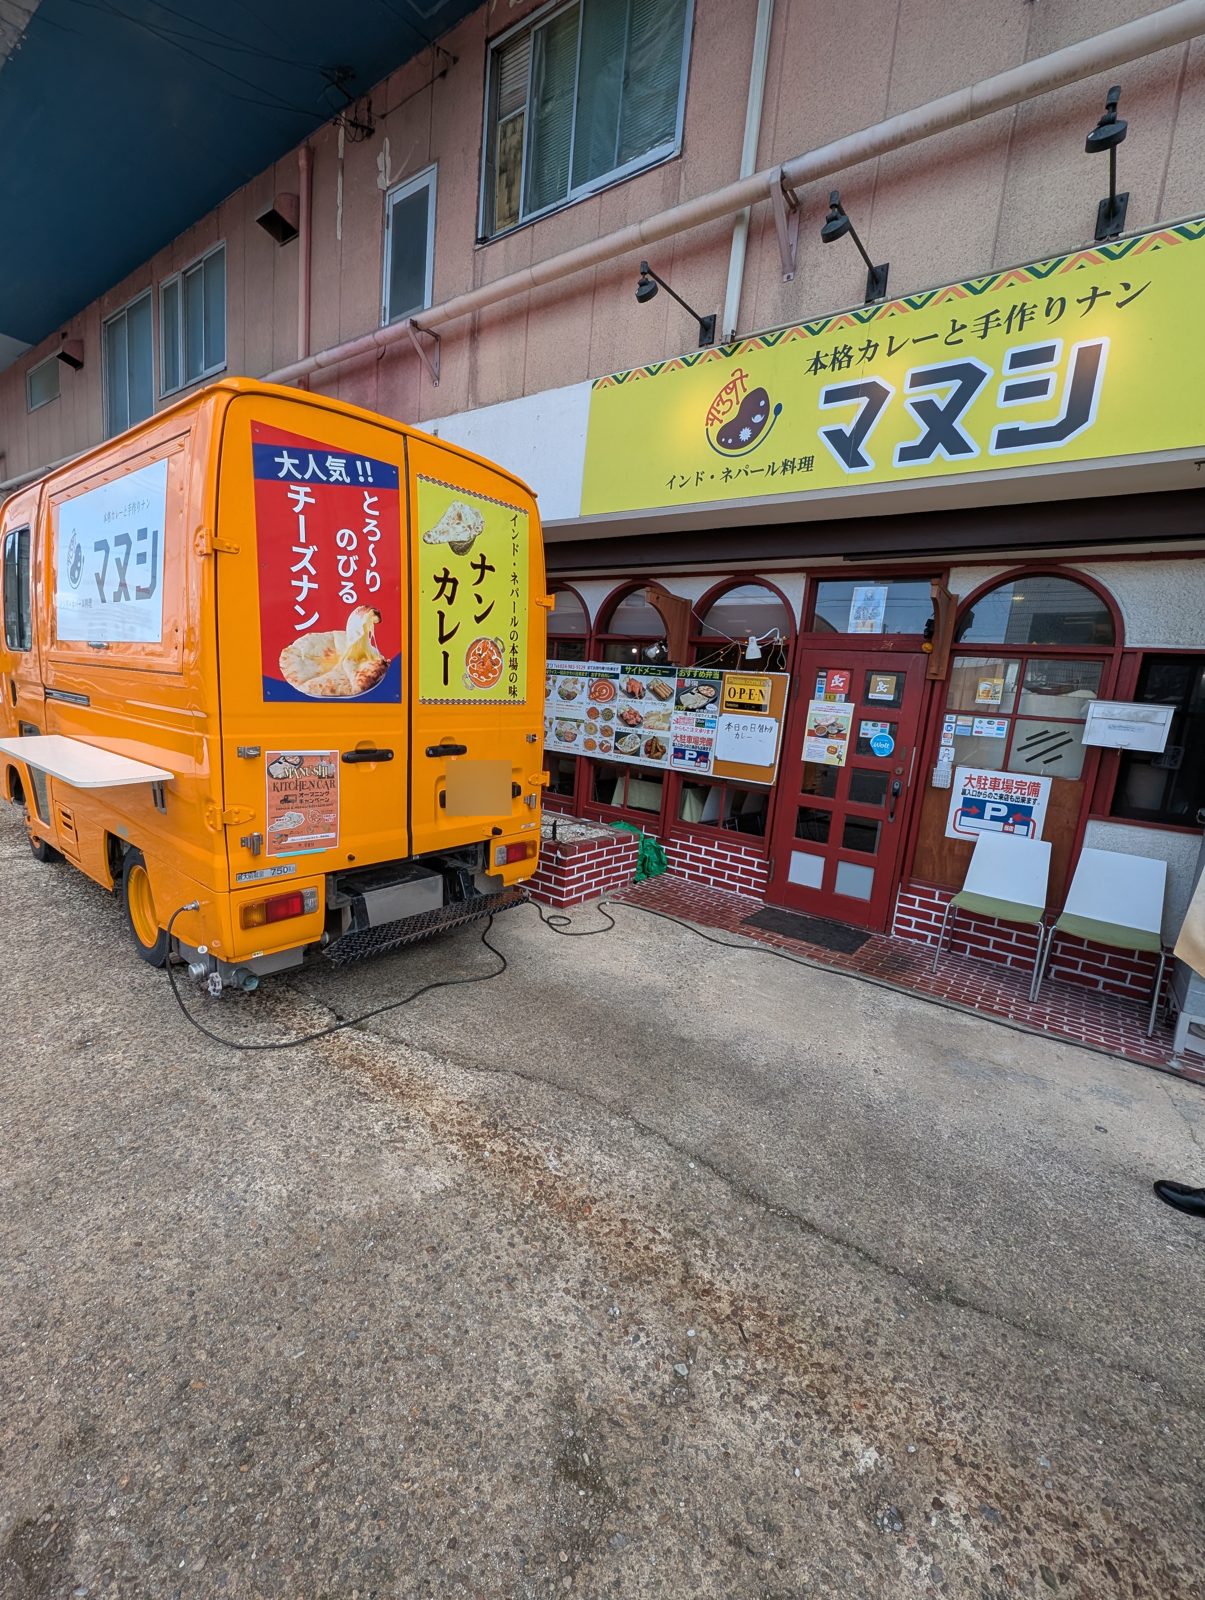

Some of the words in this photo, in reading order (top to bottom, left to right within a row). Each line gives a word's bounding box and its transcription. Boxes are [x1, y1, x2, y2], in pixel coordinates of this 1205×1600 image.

[803, 280, 1152, 377] 本格カレーと手作りナン
[819, 338, 1108, 471] マヌシ
[664, 454, 815, 490] インド・ネパール料理
[93, 527, 159, 604] マヌシ
[287, 484, 320, 631] チーズナン
[335, 528, 359, 604] のびる
[470, 552, 496, 624] ナン
[432, 567, 461, 686] カレー
[507, 514, 520, 698] インド・ネパールの本場の味
[625, 666, 670, 676] サイドメニュー
[678, 669, 721, 679] おすすめ弁当
[272, 780, 315, 793] KITCHEN
[316, 779, 336, 791] CAR
[685, 750, 698, 760] P
[963, 774, 1041, 797] 大駐車場完備
[983, 802, 1008, 820] P
